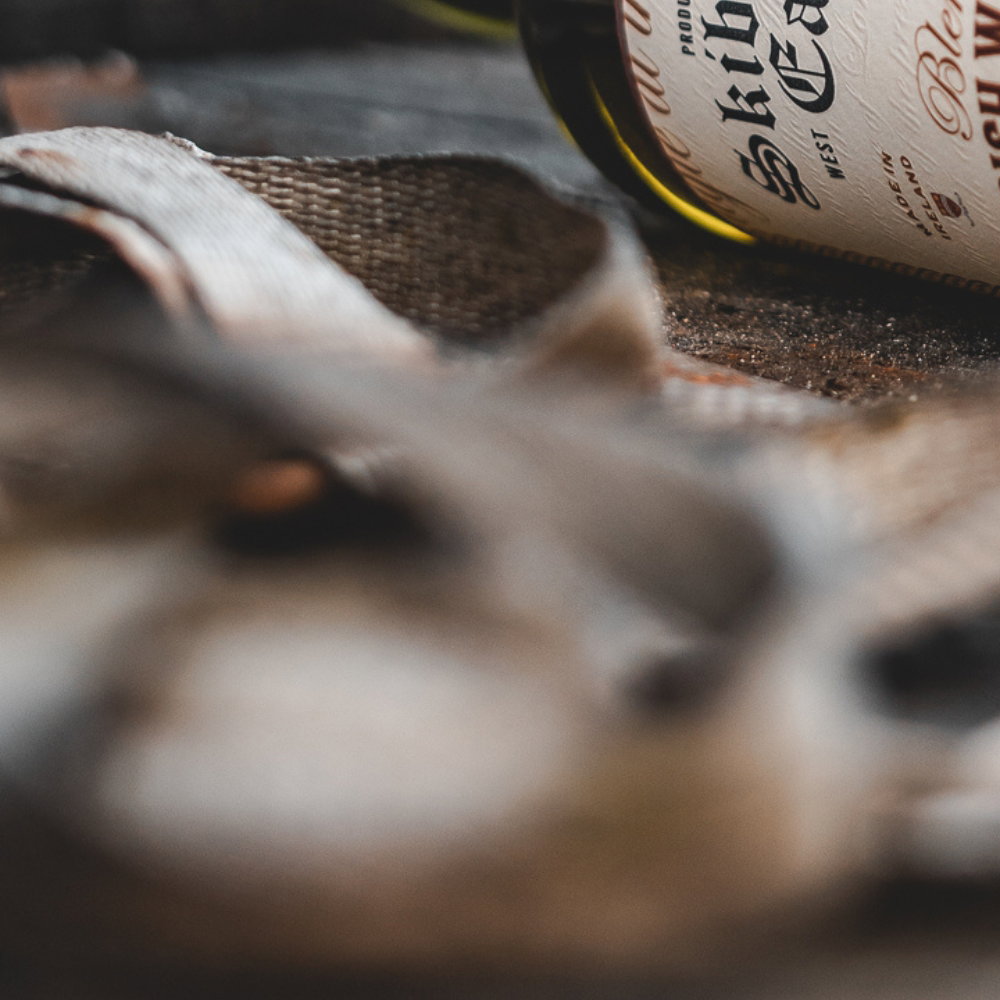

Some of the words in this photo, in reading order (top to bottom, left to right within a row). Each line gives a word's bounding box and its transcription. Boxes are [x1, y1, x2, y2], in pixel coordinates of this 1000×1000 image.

[811, 128, 846, 180] WEST
[881, 150, 895, 175] IN
[887, 179, 933, 237] MADE
[899, 154, 953, 241] IRELAND
